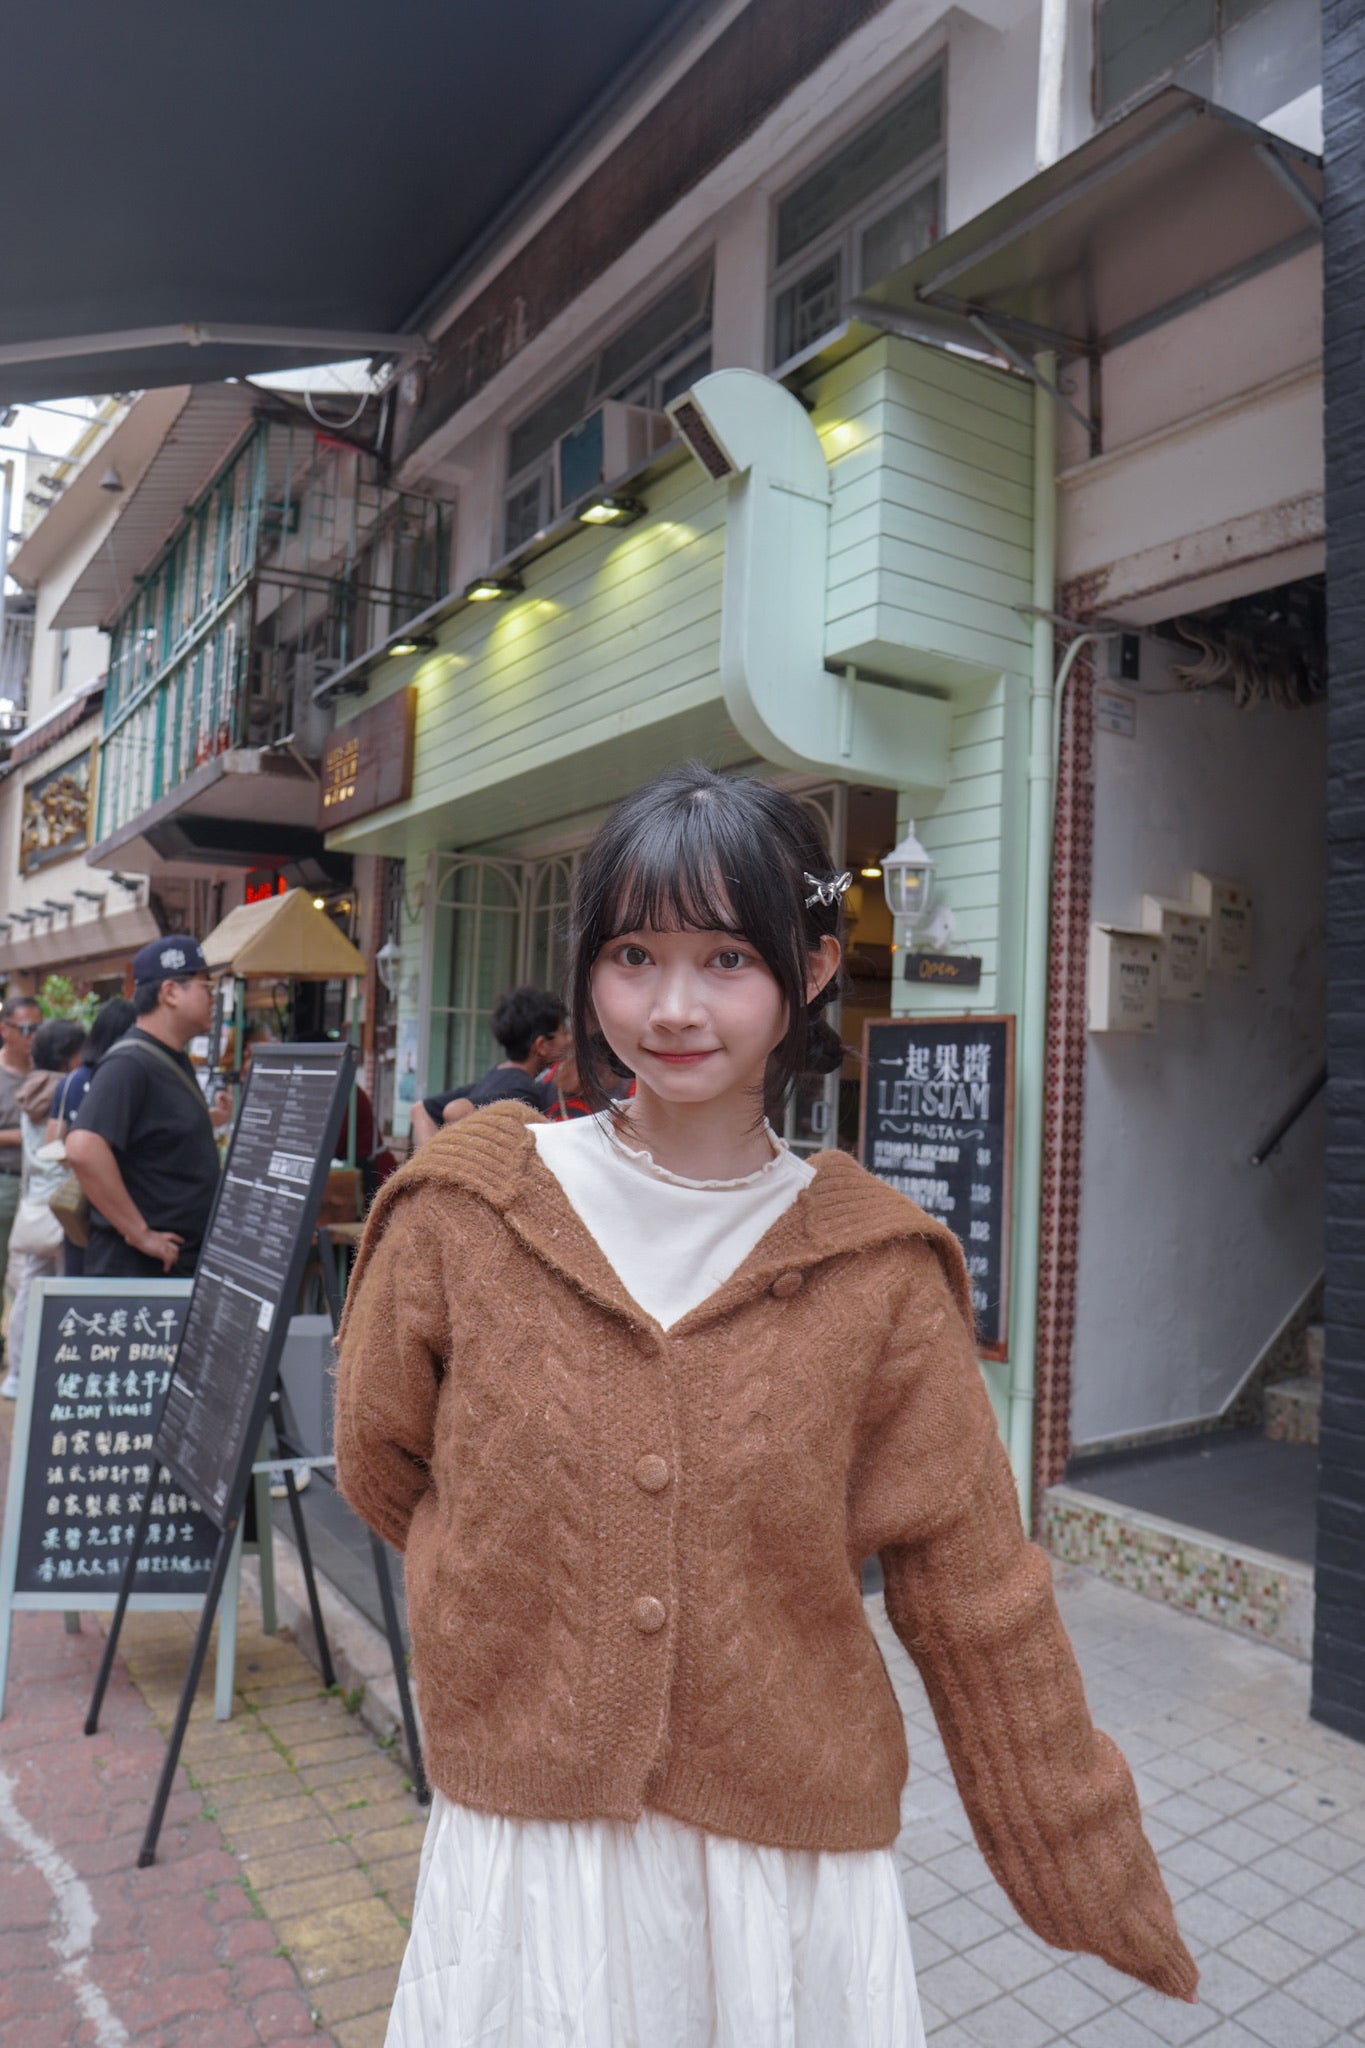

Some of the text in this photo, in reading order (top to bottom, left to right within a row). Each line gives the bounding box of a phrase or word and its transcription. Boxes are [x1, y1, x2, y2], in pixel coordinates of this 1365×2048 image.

[918, 959, 960, 979] Open
[879, 1041, 992, 1083] 一起果醬
[912, 1121, 956, 1141] PASTA
[54, 1343, 82, 1365] ALL
[90, 1343, 120, 1363] DAY
[50, 1403, 75, 1422] ALL
[77, 1403, 103, 1420] DAY
